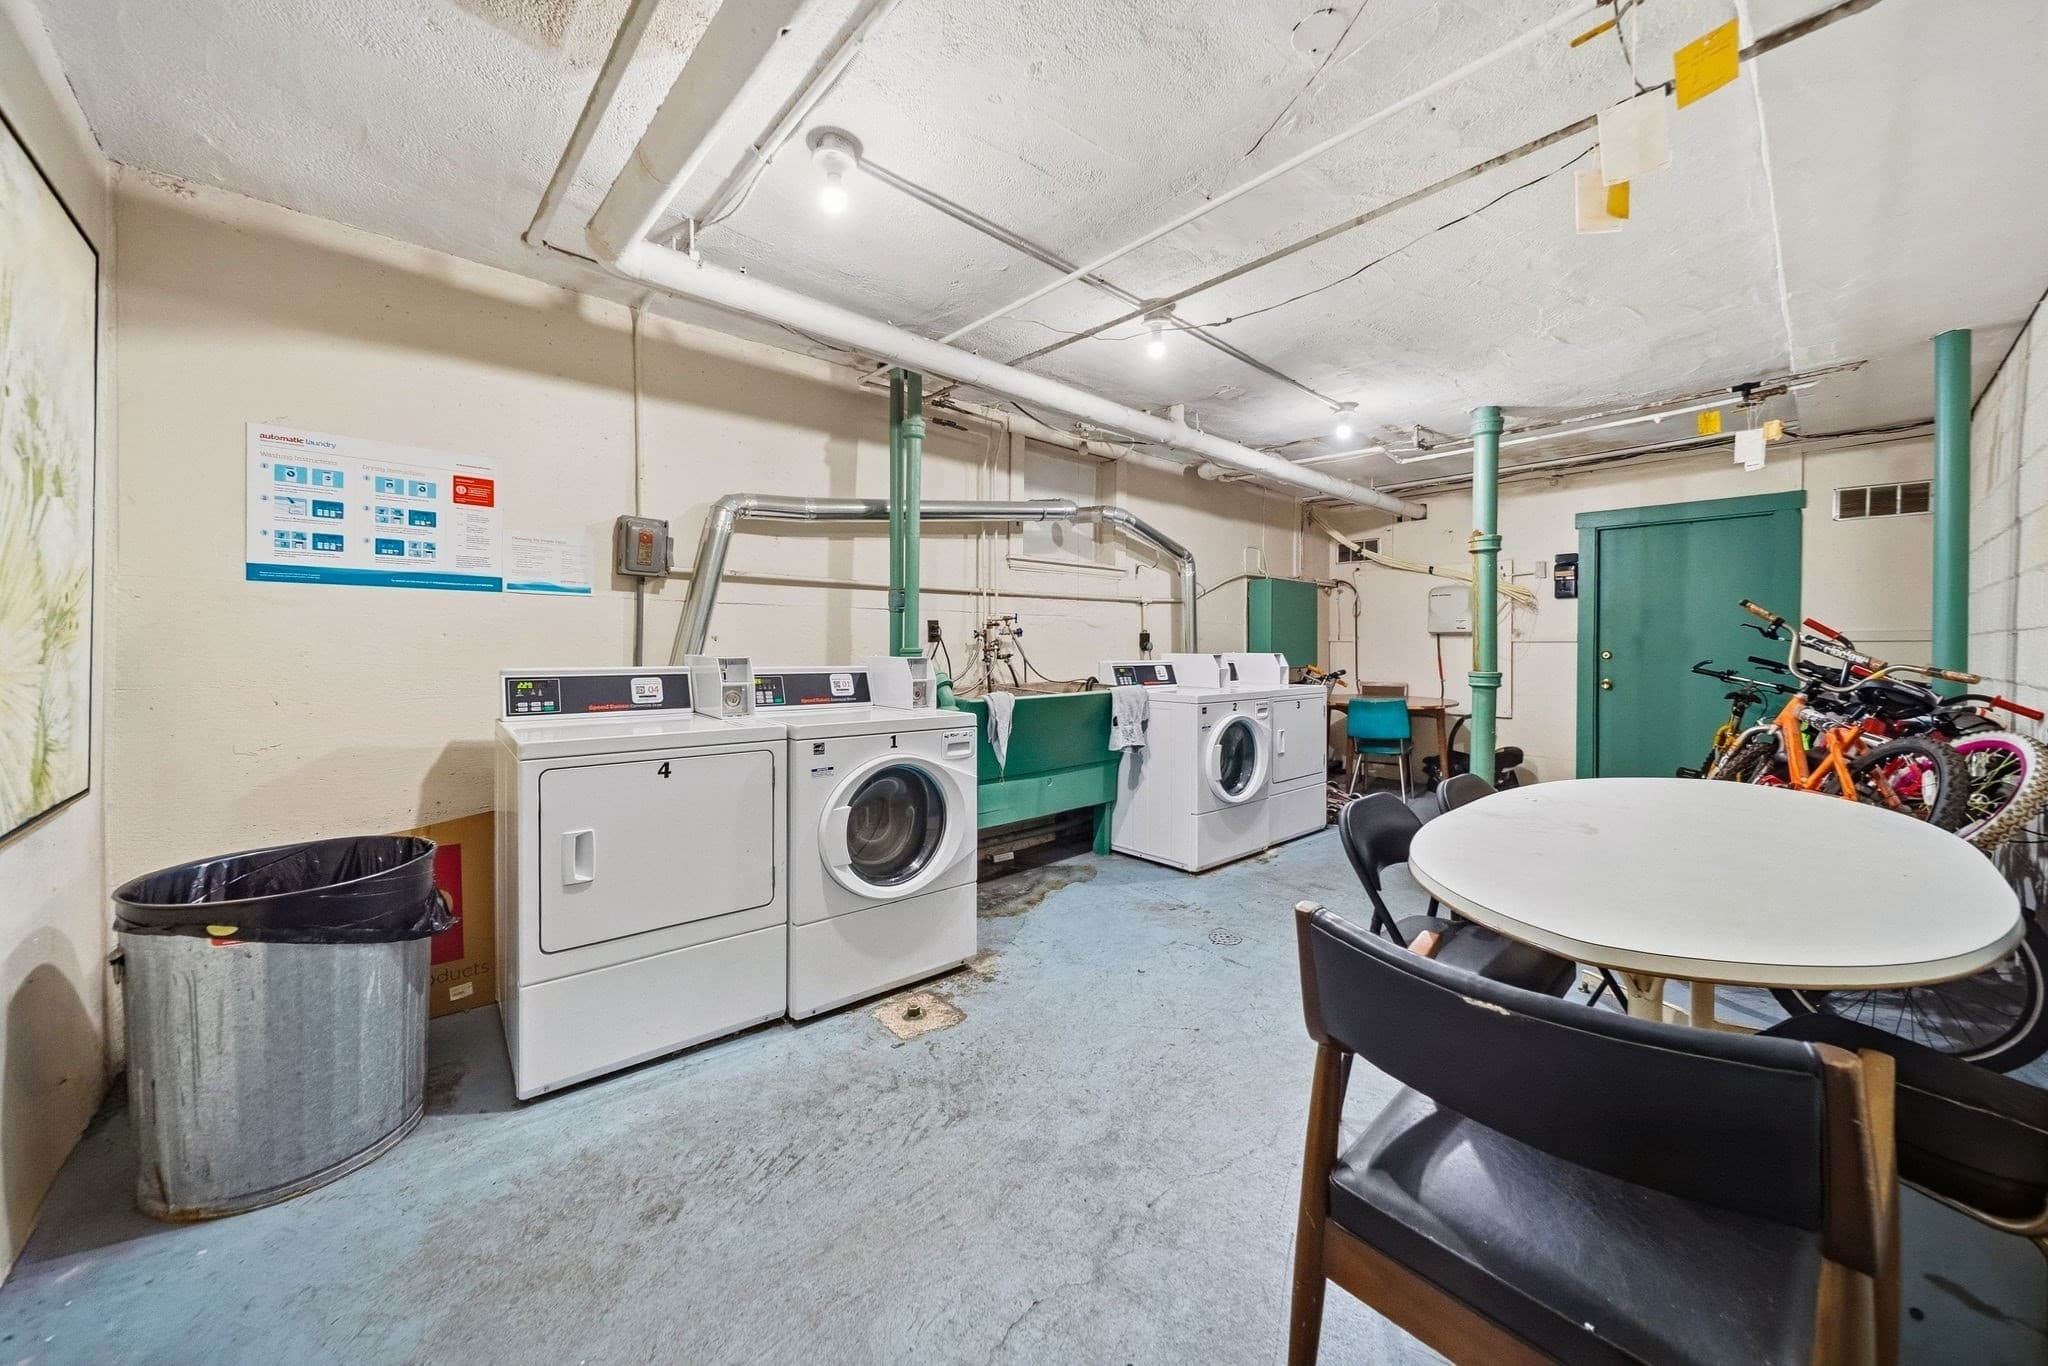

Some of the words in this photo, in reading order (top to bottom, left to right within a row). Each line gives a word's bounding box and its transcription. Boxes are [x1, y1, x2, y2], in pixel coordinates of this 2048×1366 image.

[259, 432, 304, 444] automatic
[305, 438, 337, 449] laundry
[259, 450, 293, 461] Washing
[647, 685, 659, 694] 04
[1232, 702, 1238, 711] 2
[1296, 701, 1301, 710] 3
[890, 734, 898, 748] 1
[657, 761, 672, 779] 4
